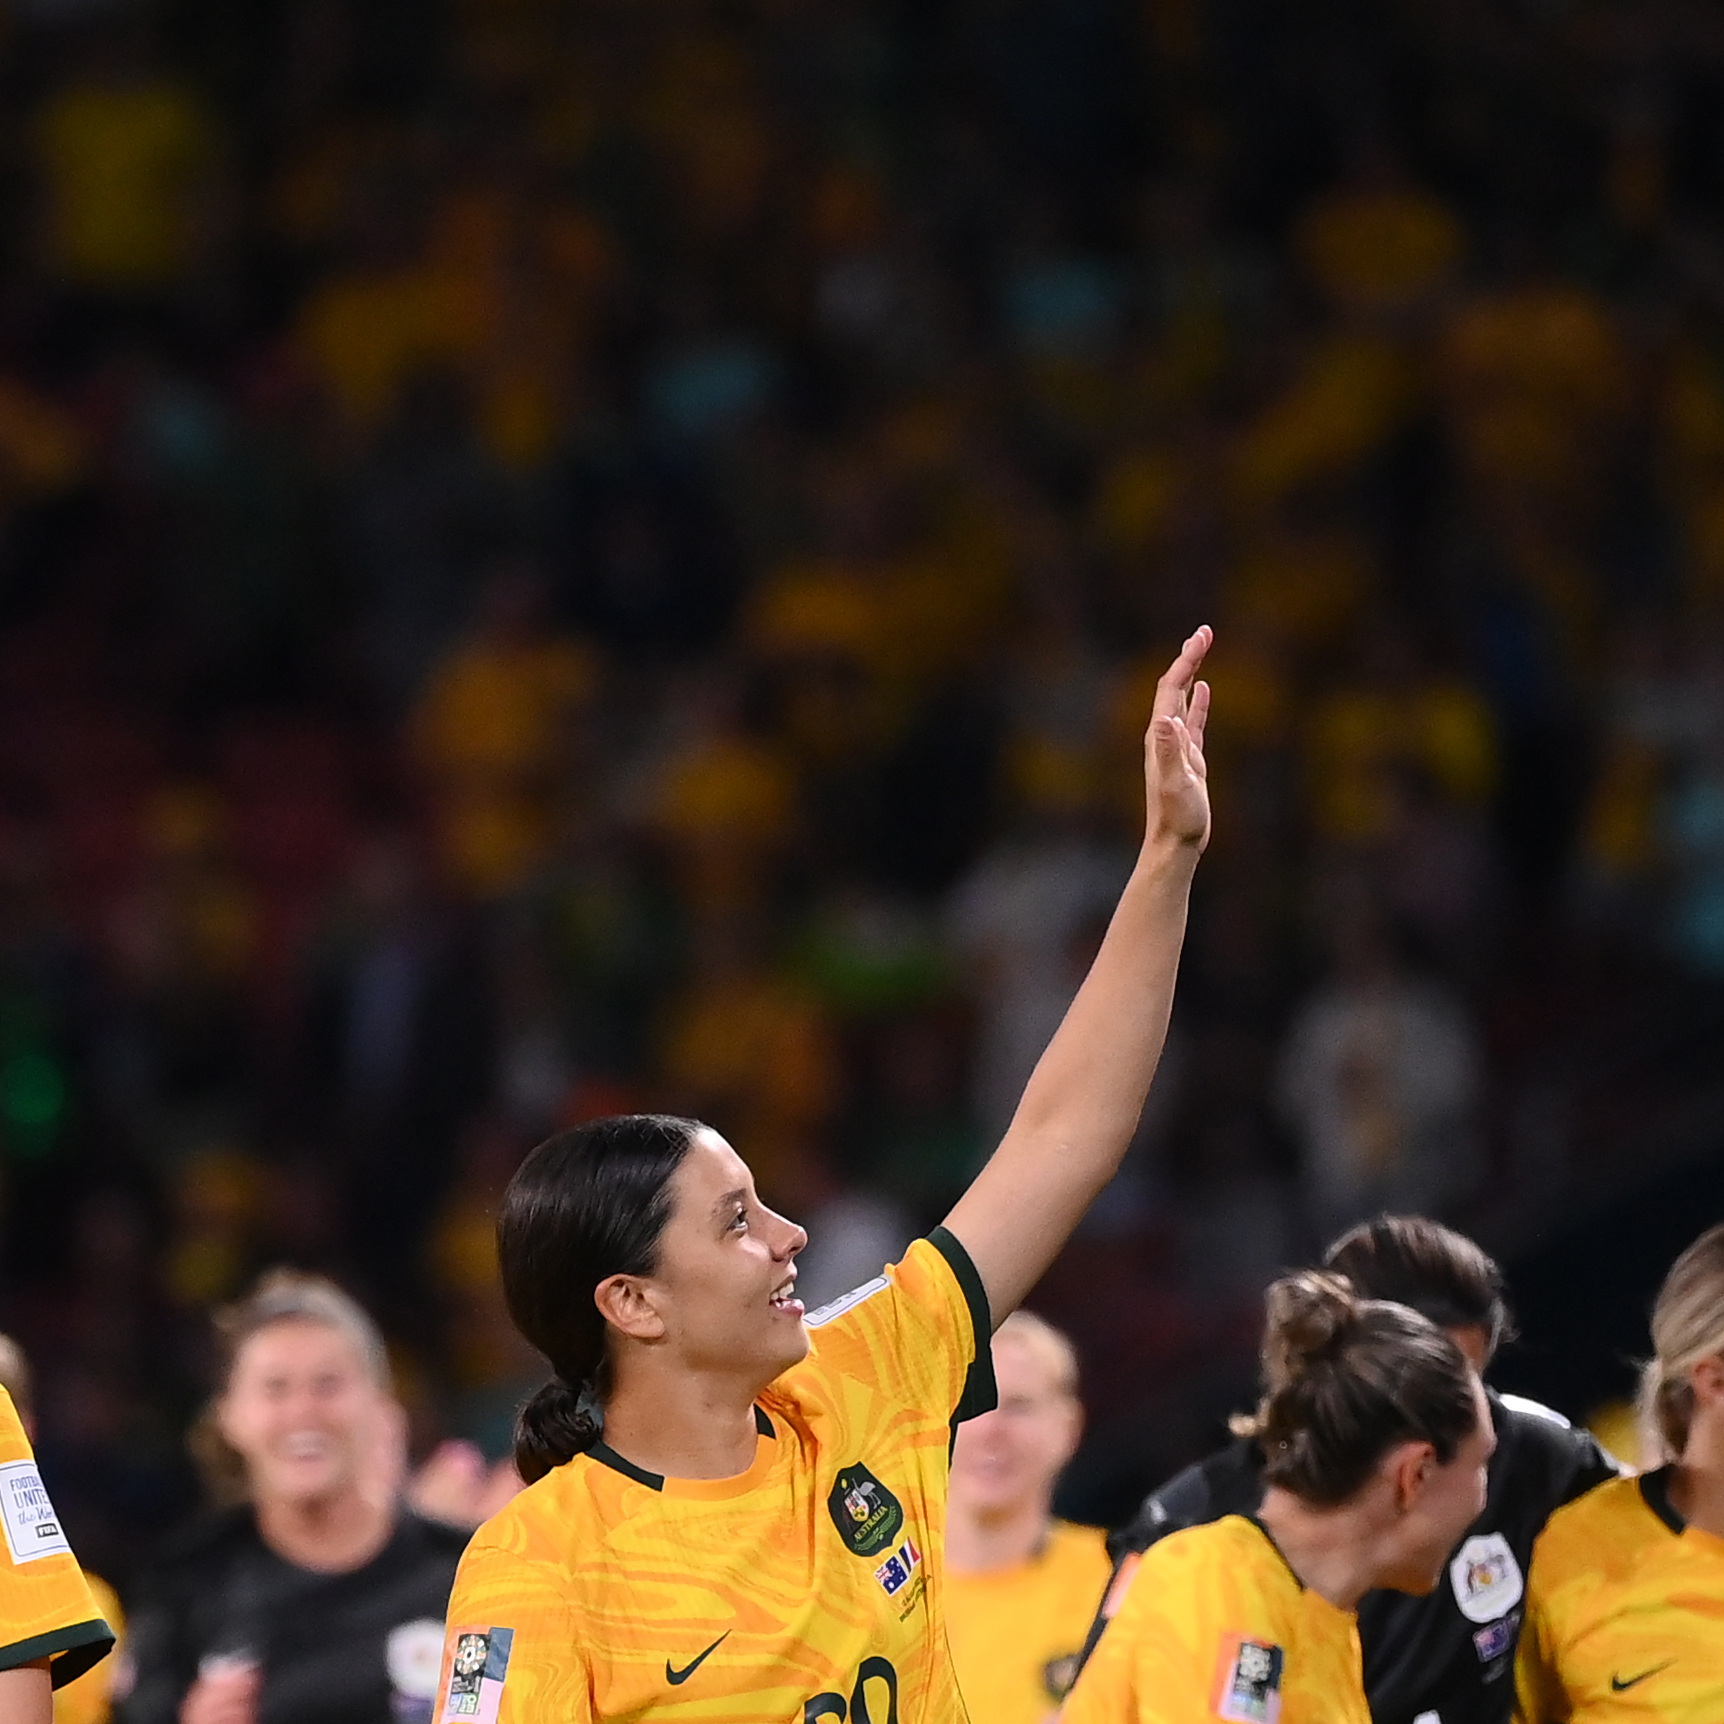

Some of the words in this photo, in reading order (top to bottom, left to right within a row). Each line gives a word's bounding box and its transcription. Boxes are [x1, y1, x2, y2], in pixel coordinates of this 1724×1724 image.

[10, 1476, 42, 1491] FOOTBA
[13, 1488, 50, 1509] UNITE
[853, 1505, 889, 1542] AUSTRALIA
